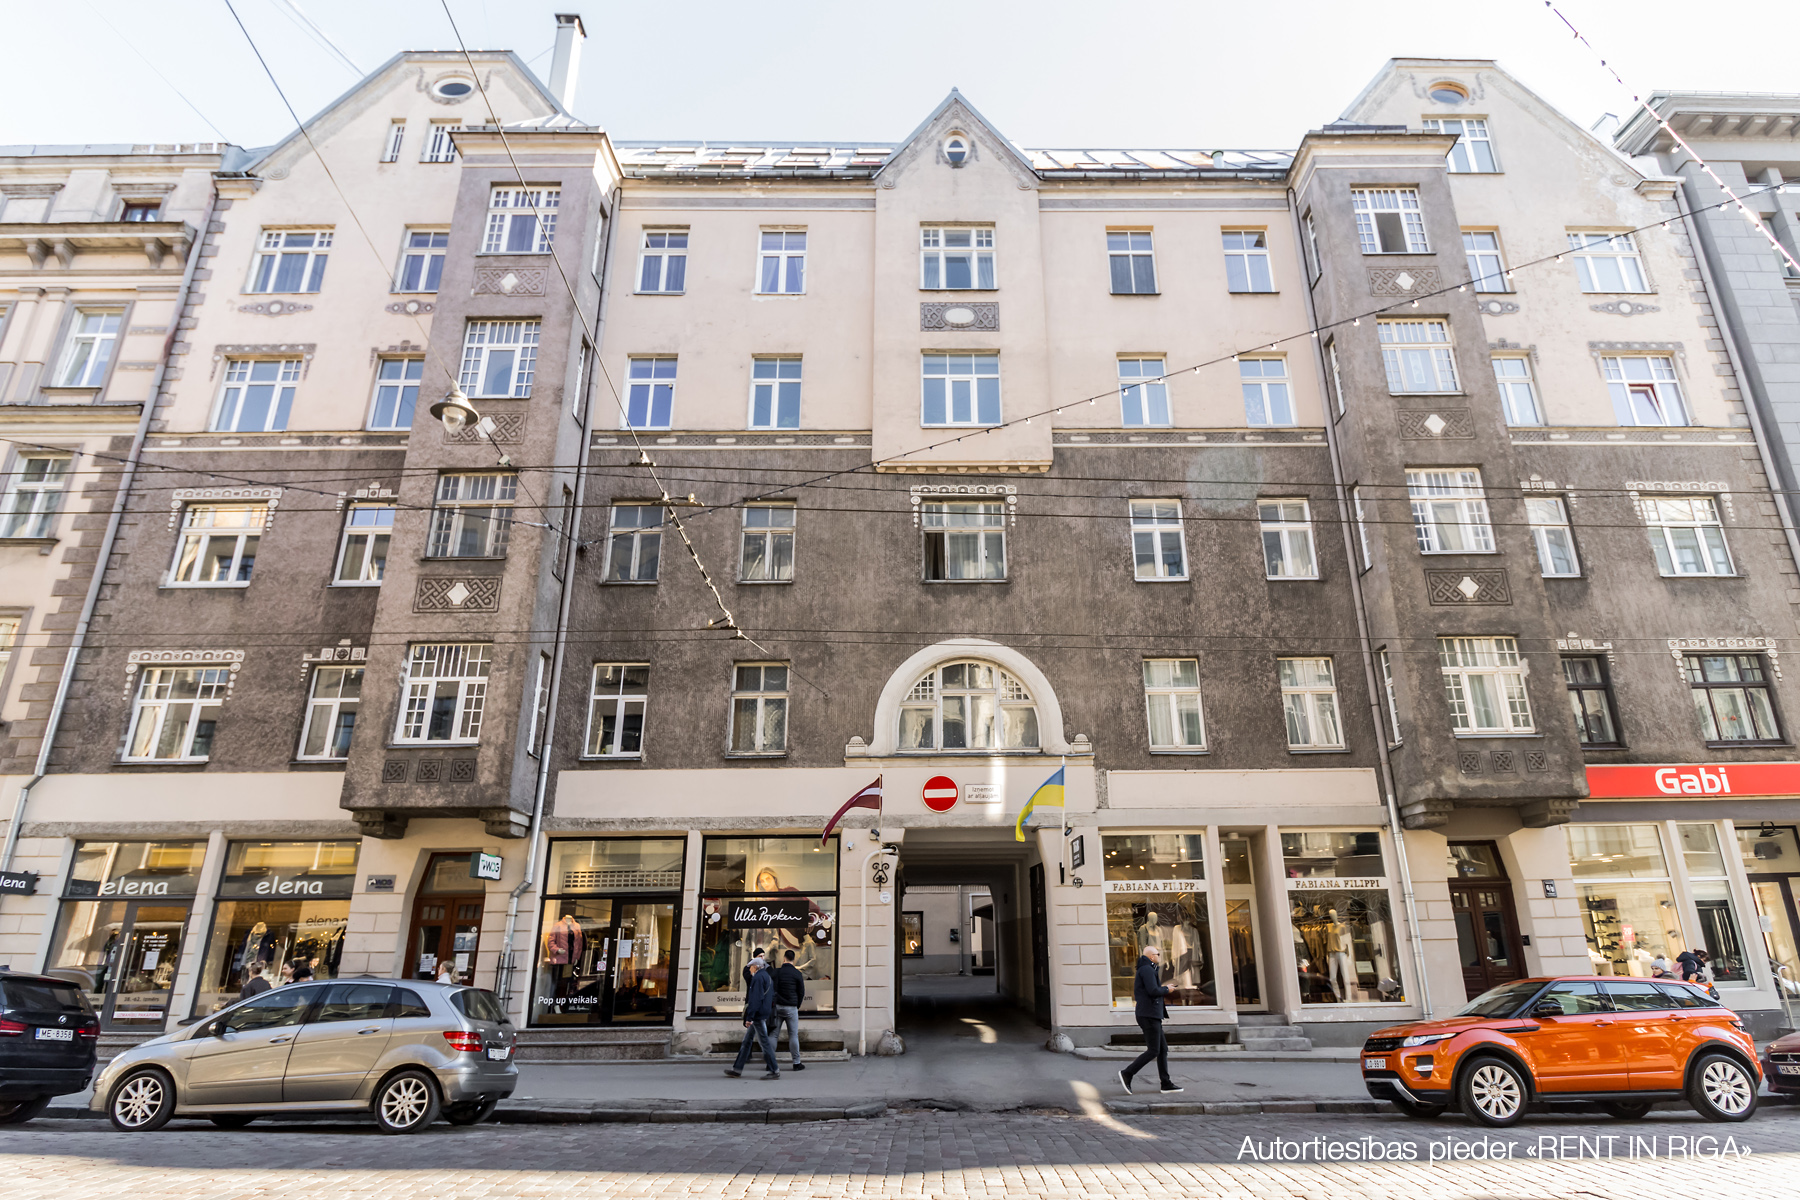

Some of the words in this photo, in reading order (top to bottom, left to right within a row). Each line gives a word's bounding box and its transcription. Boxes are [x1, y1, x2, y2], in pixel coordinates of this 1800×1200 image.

[1655, 767, 1731, 794] Gabi
[102, 876, 168, 895] elena
[255, 875, 323, 895] elena
[1113, 882, 1160, 891] FABIANA
[1295, 880, 1341, 888] FABIANA
[1344, 879, 1380, 888] FILIPPI
[306, 915, 339, 927] elena
[734, 906, 757, 922] Ulla
[759, 906, 802, 925] Popken
[538, 996, 554, 1006] Pop
[555, 996, 566, 1006] up
[568, 995, 598, 1004] veikals
[41, 1029, 72, 1039] ME-8358
